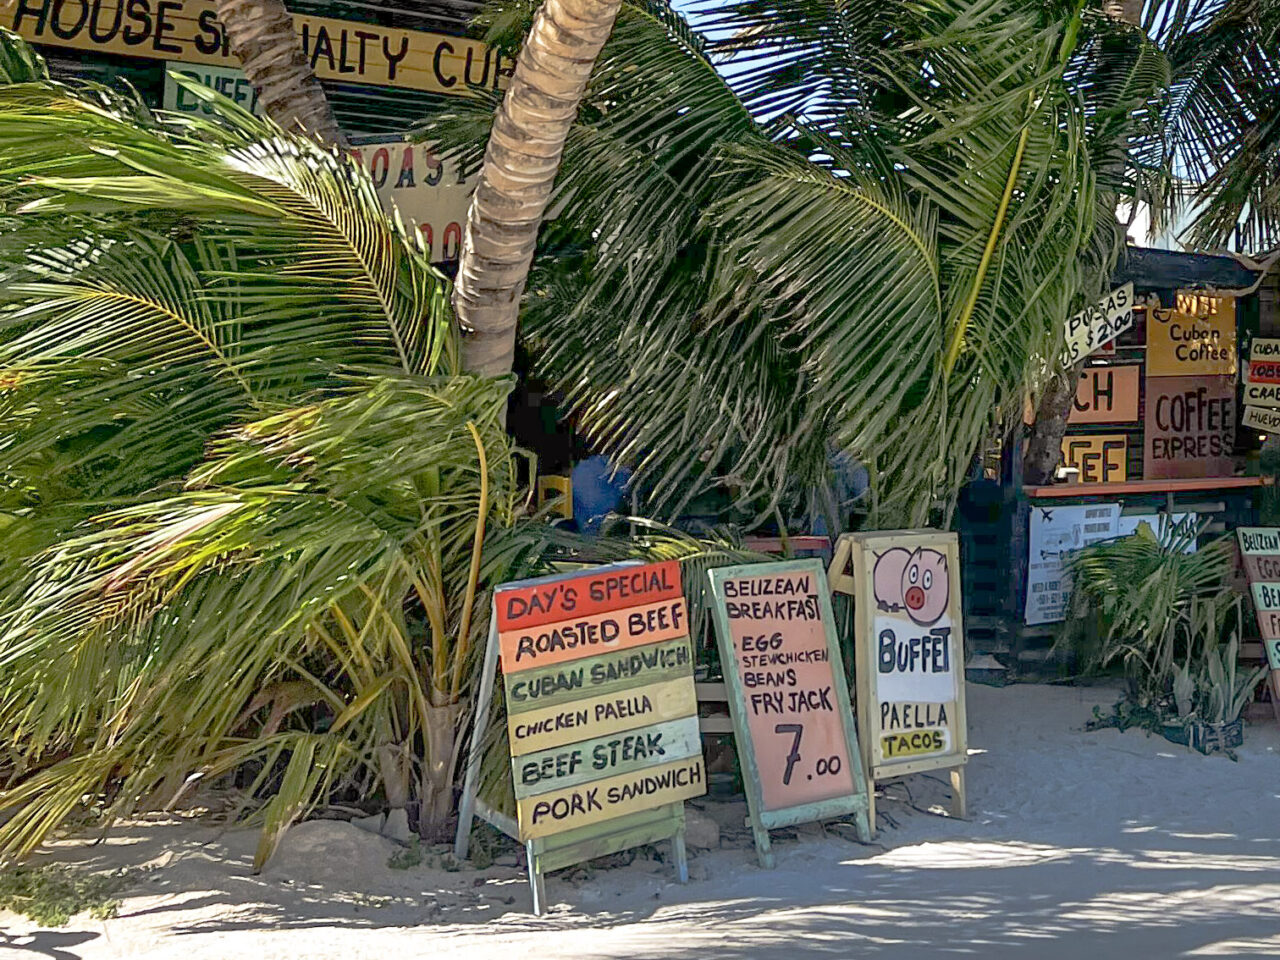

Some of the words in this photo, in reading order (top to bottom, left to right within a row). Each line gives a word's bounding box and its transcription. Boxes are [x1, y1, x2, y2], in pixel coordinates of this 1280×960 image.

[194, 10, 409, 81] SIALTY
[1170, 324, 1221, 341] Cuban
[1175, 344, 1228, 361] Coffee
[1156, 388, 1232, 433] COFFEE
[507, 584, 578, 620] DAY'S
[590, 568, 675, 602] SPECIAL
[724, 576, 809, 598] BELIZEAN
[726, 594, 821, 621] BREAKFAST
[516, 618, 620, 662] ROASTED
[628, 602, 684, 636] BEEF
[742, 632, 783, 651] EGG
[878, 627, 952, 673] BUFFET
[511, 667, 584, 701] CUBAN
[590, 645, 689, 685] SANDWICH
[744, 669, 797, 688] BEANS
[515, 709, 588, 739] CHICKEN
[595, 695, 653, 722] PAELLA
[751, 692, 784, 716] FRY
[788, 686, 833, 713] JACK
[881, 702, 948, 730] PAELLA
[522, 750, 583, 786] BEEF
[592, 733, 666, 771] STEAK
[883, 732, 943, 755] TACOS
[532, 788, 603, 824] PORK
[607, 762, 701, 804] SANDWICH
